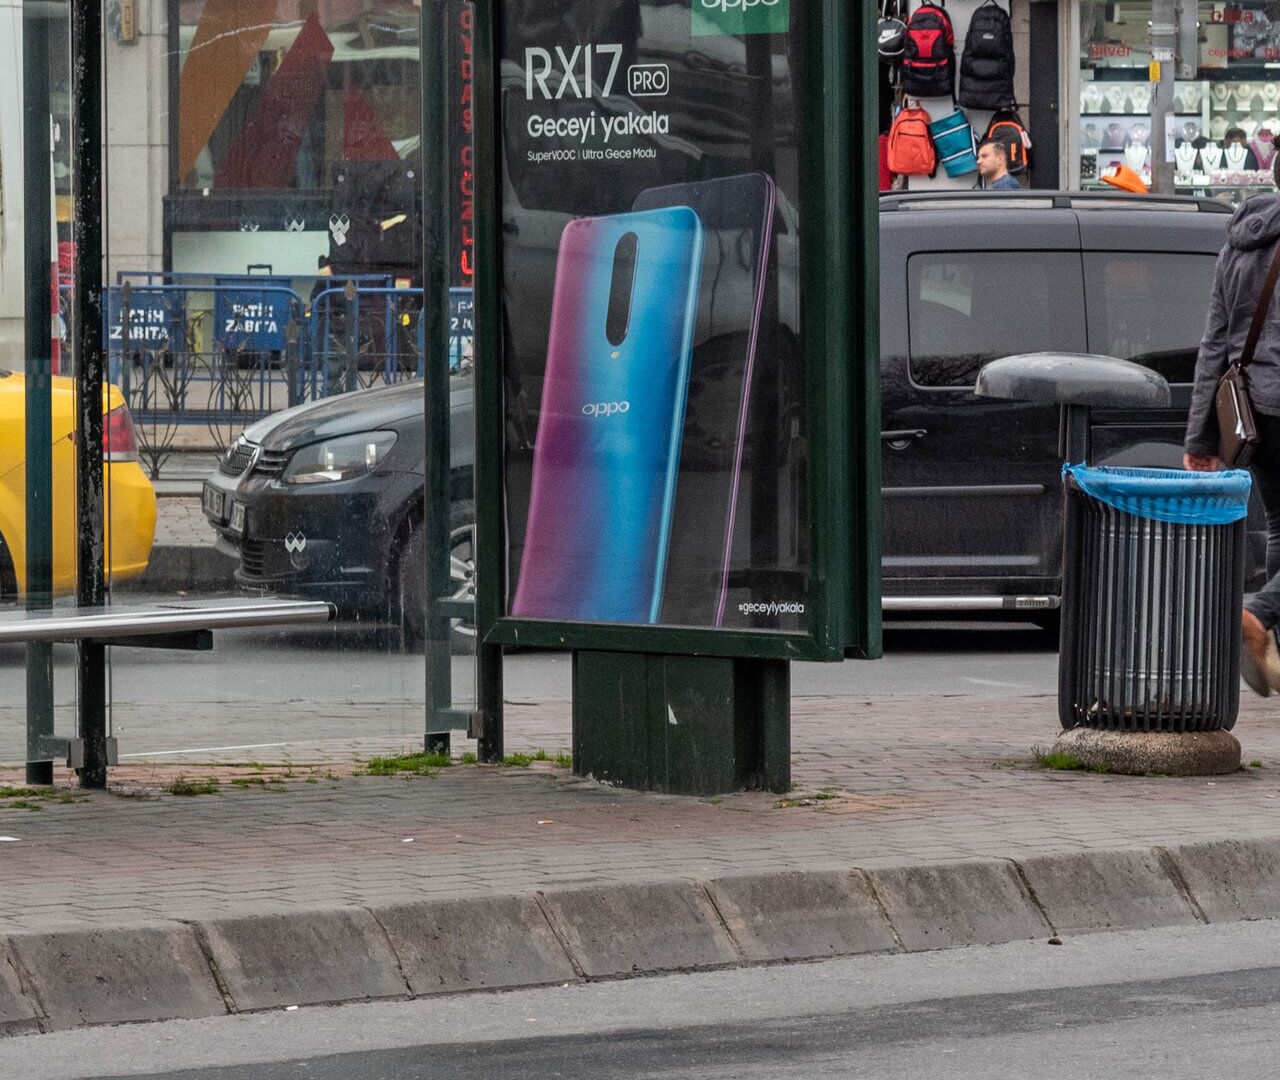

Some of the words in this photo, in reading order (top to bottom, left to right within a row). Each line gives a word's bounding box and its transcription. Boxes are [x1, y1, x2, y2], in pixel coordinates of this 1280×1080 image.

[525, 44, 623, 101] RX17
[634, 70, 666, 91] PRO
[527, 112, 595, 144] Geceyi
[601, 111, 669, 143] yakala
[527, 150, 577, 164] SuperVOOC
[582, 149, 604, 160] Ultra
[605, 148, 632, 159] Gece
[633, 147, 657, 159] Modu
[582, 400, 629, 417] oppo
